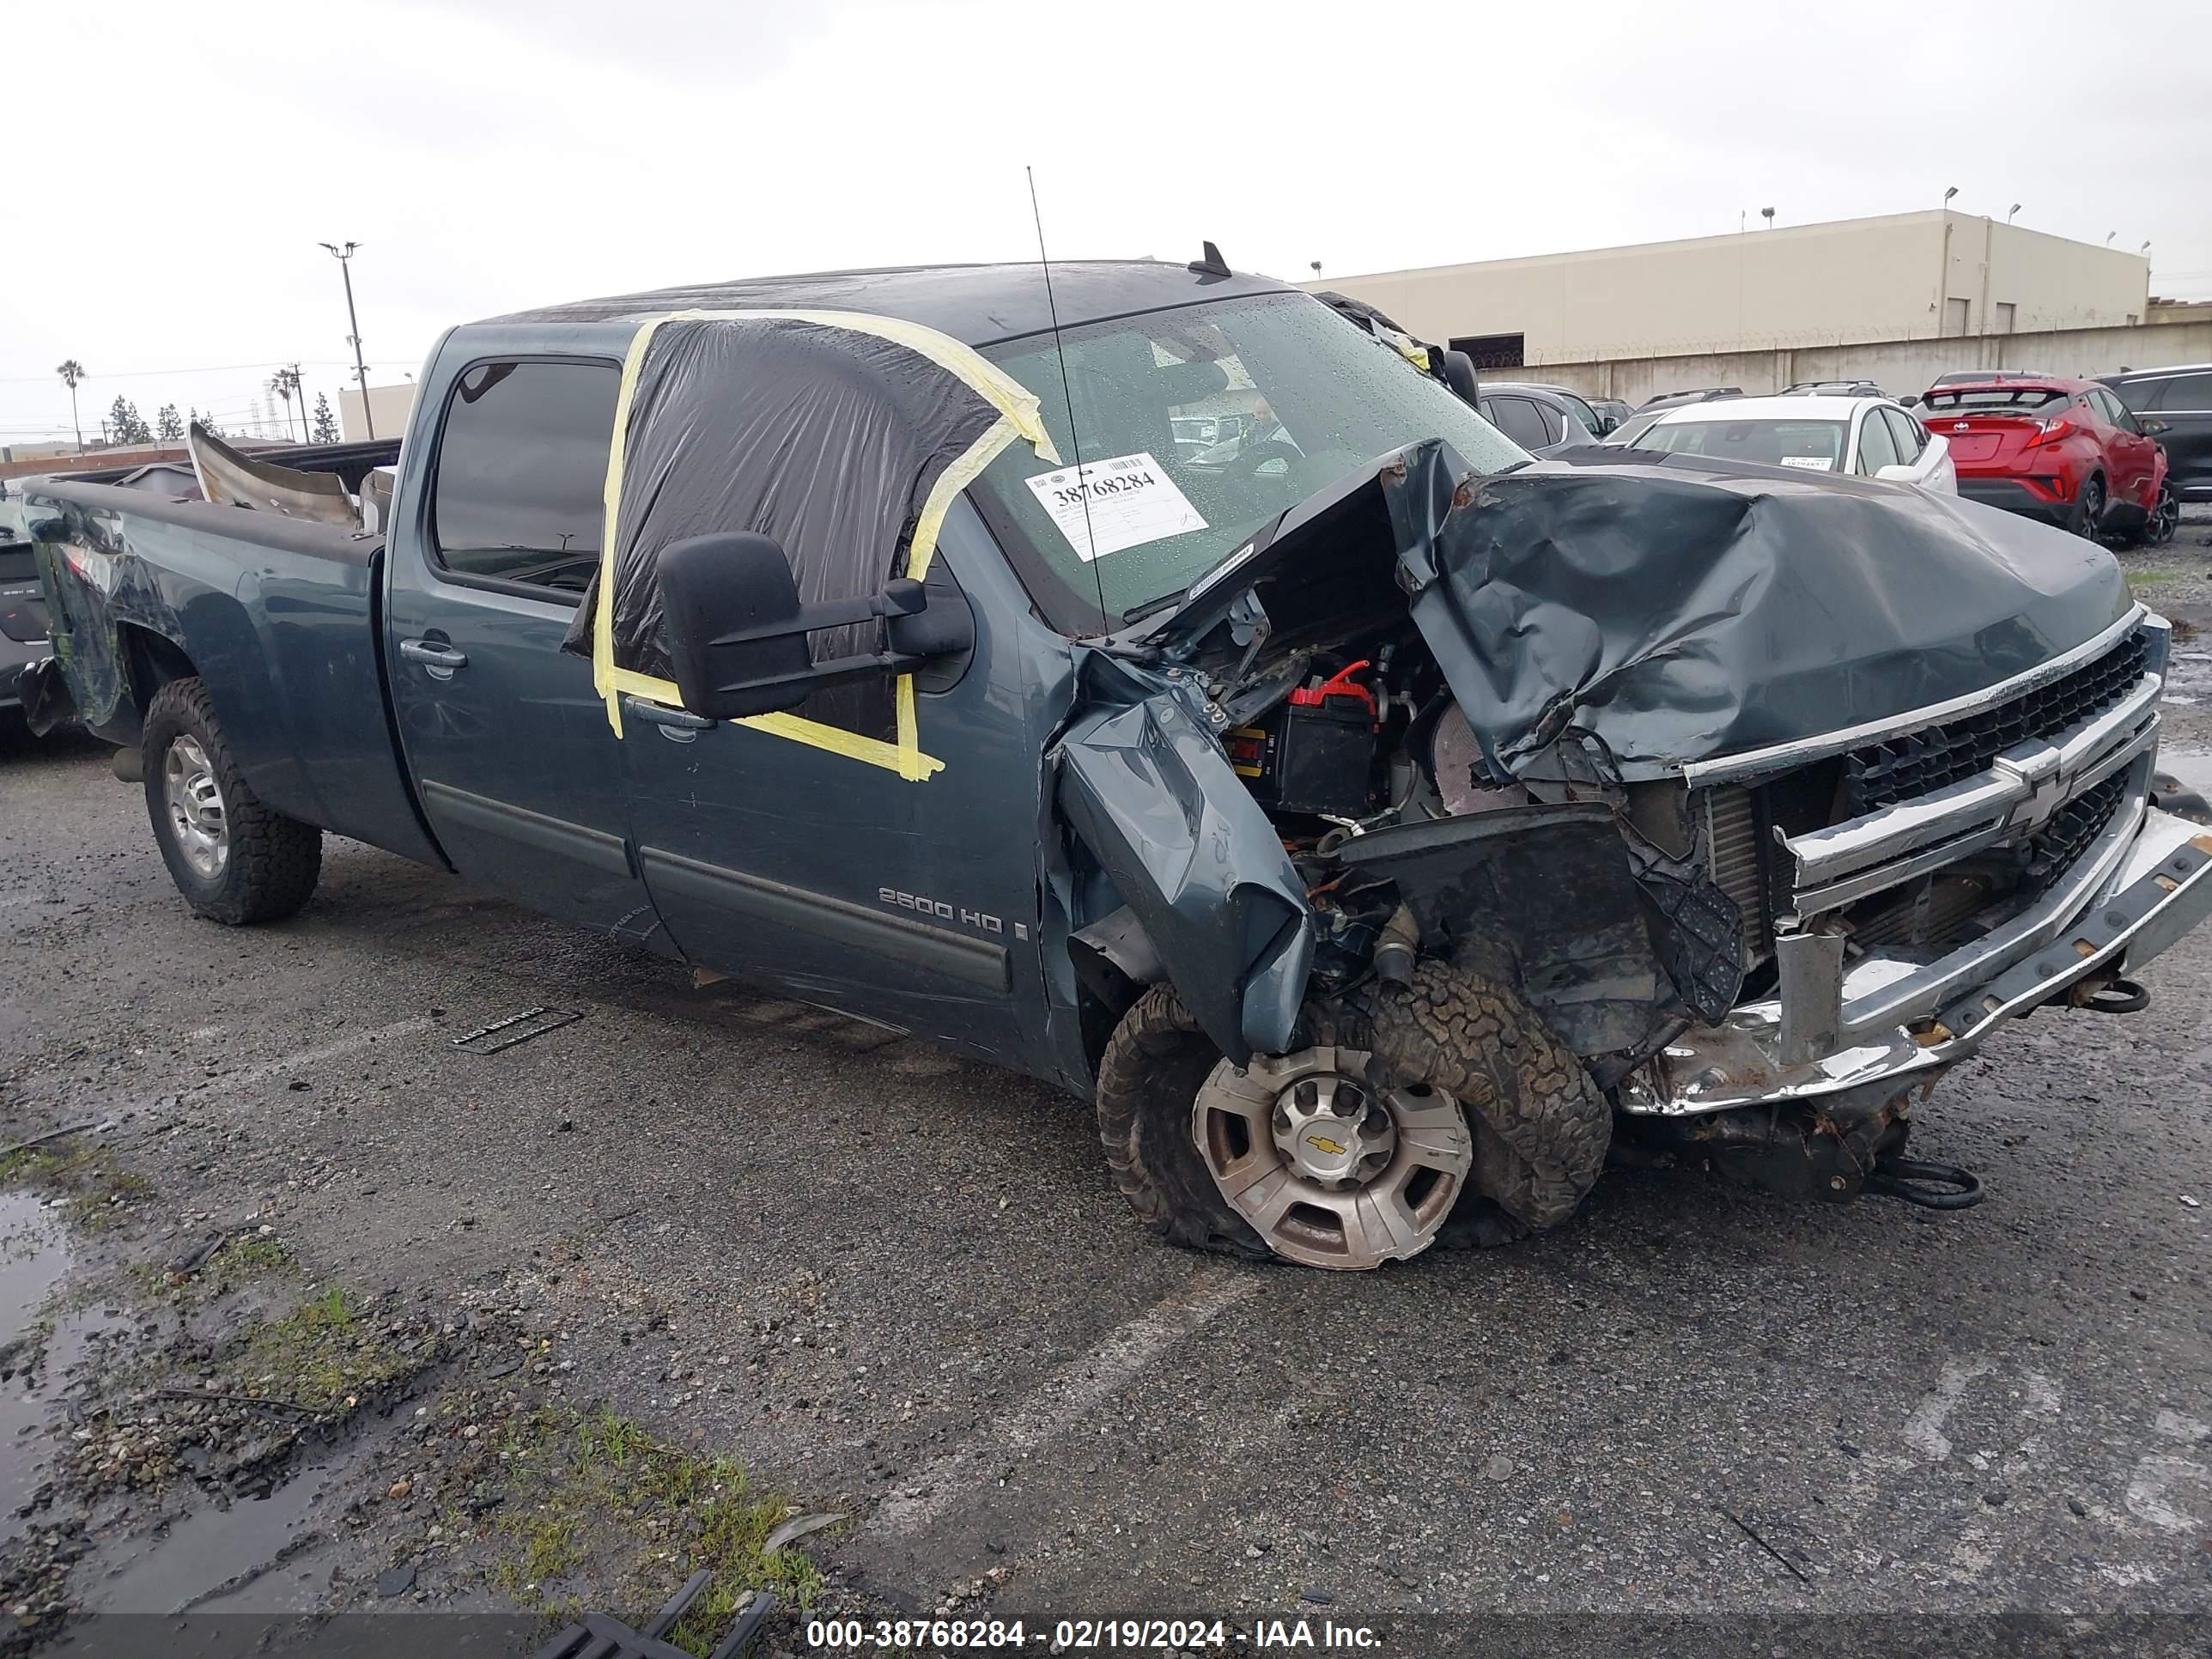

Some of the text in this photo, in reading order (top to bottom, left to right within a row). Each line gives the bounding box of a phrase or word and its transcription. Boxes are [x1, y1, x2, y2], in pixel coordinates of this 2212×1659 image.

[1053, 471, 1155, 507] 38768284
[878, 887, 1003, 934] 2500 HD
